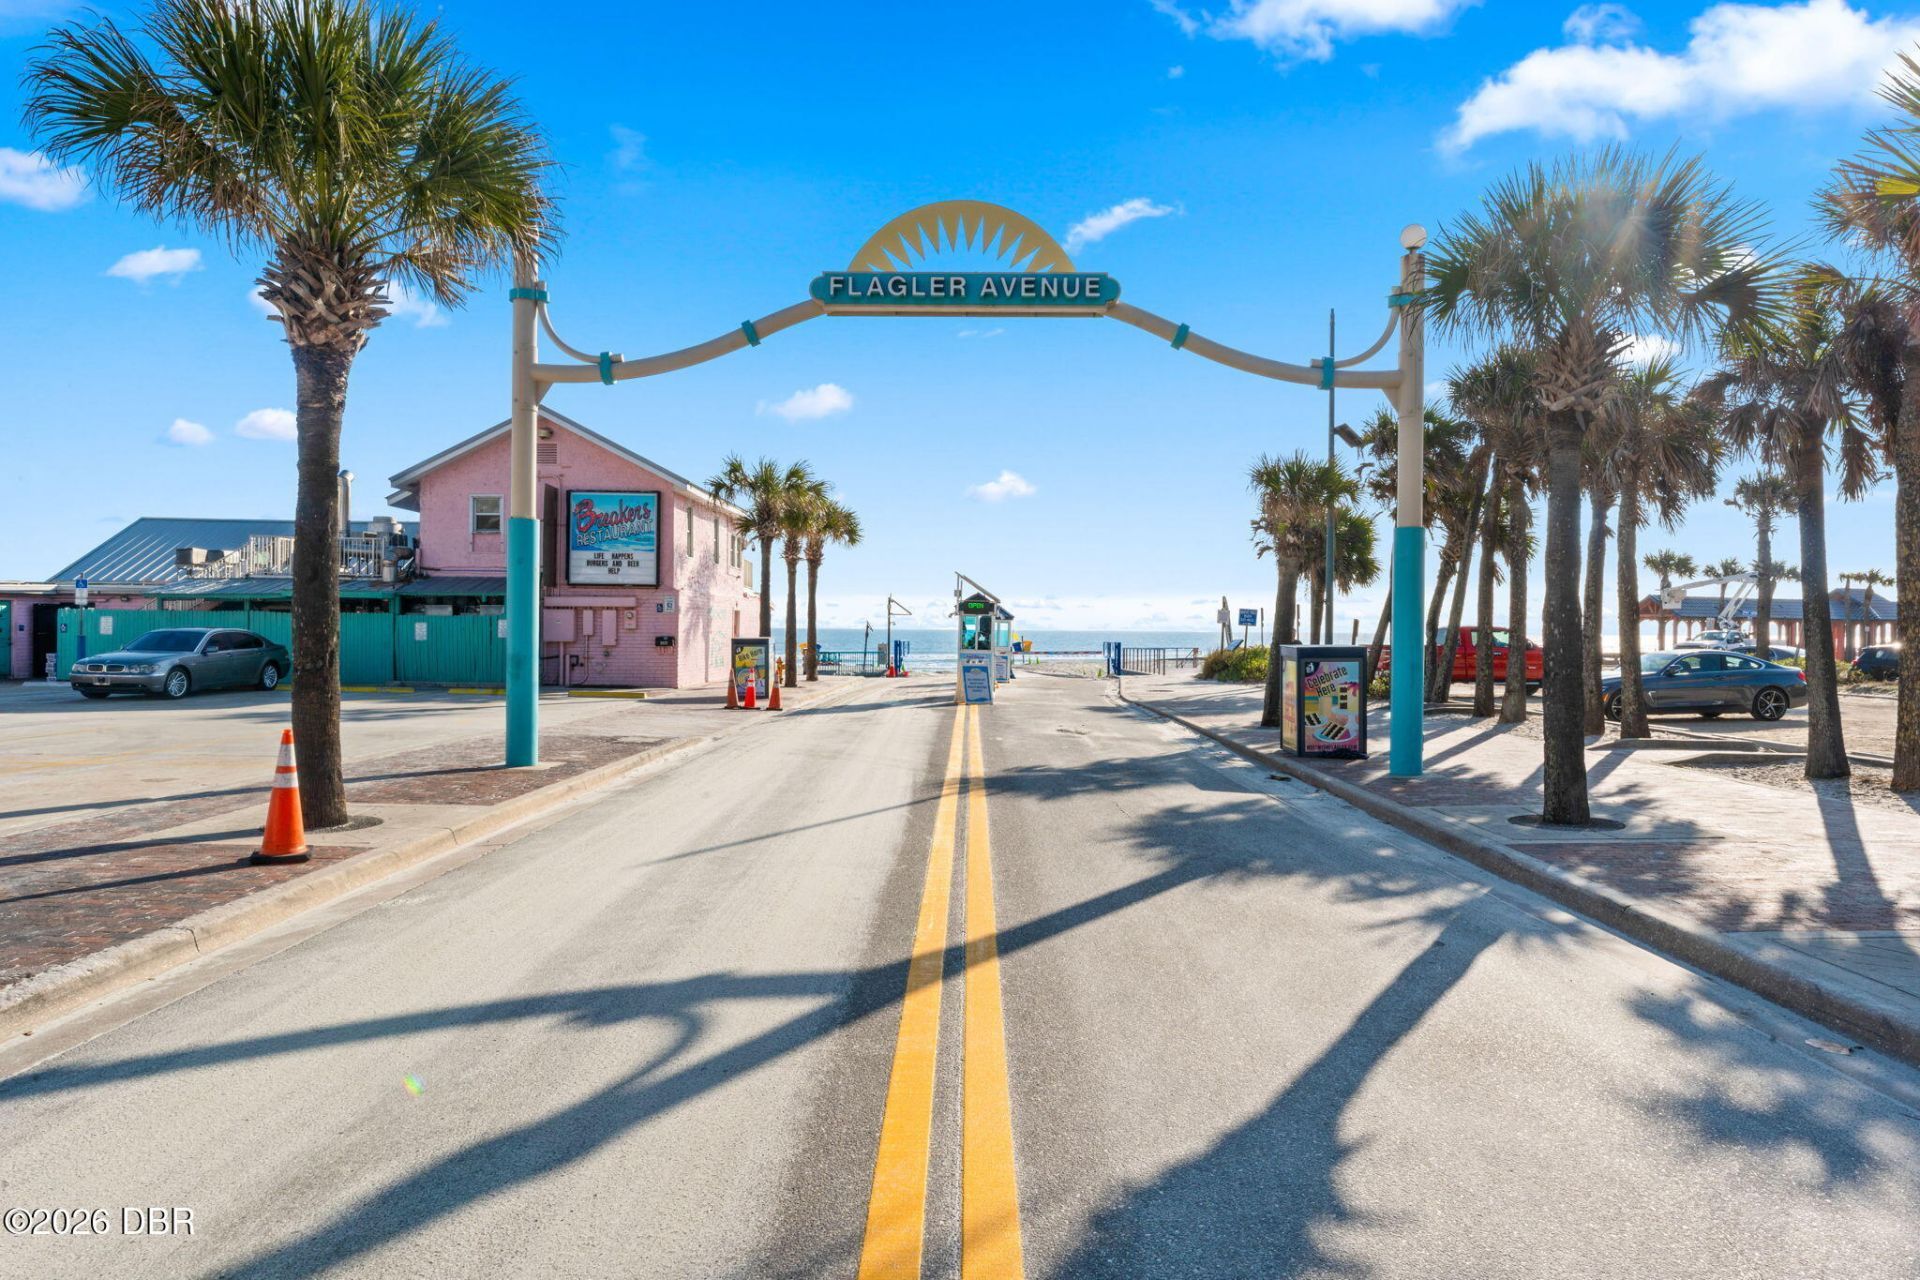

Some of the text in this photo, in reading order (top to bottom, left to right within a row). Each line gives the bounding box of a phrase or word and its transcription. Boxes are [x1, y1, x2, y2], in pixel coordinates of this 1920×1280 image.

[829, 276, 1101, 297] FLAGLER AVENUE
[576, 519, 653, 546] RESTAURANT
[1307, 666, 1348, 688] Celebrate
[1316, 684, 1336, 697] Here
